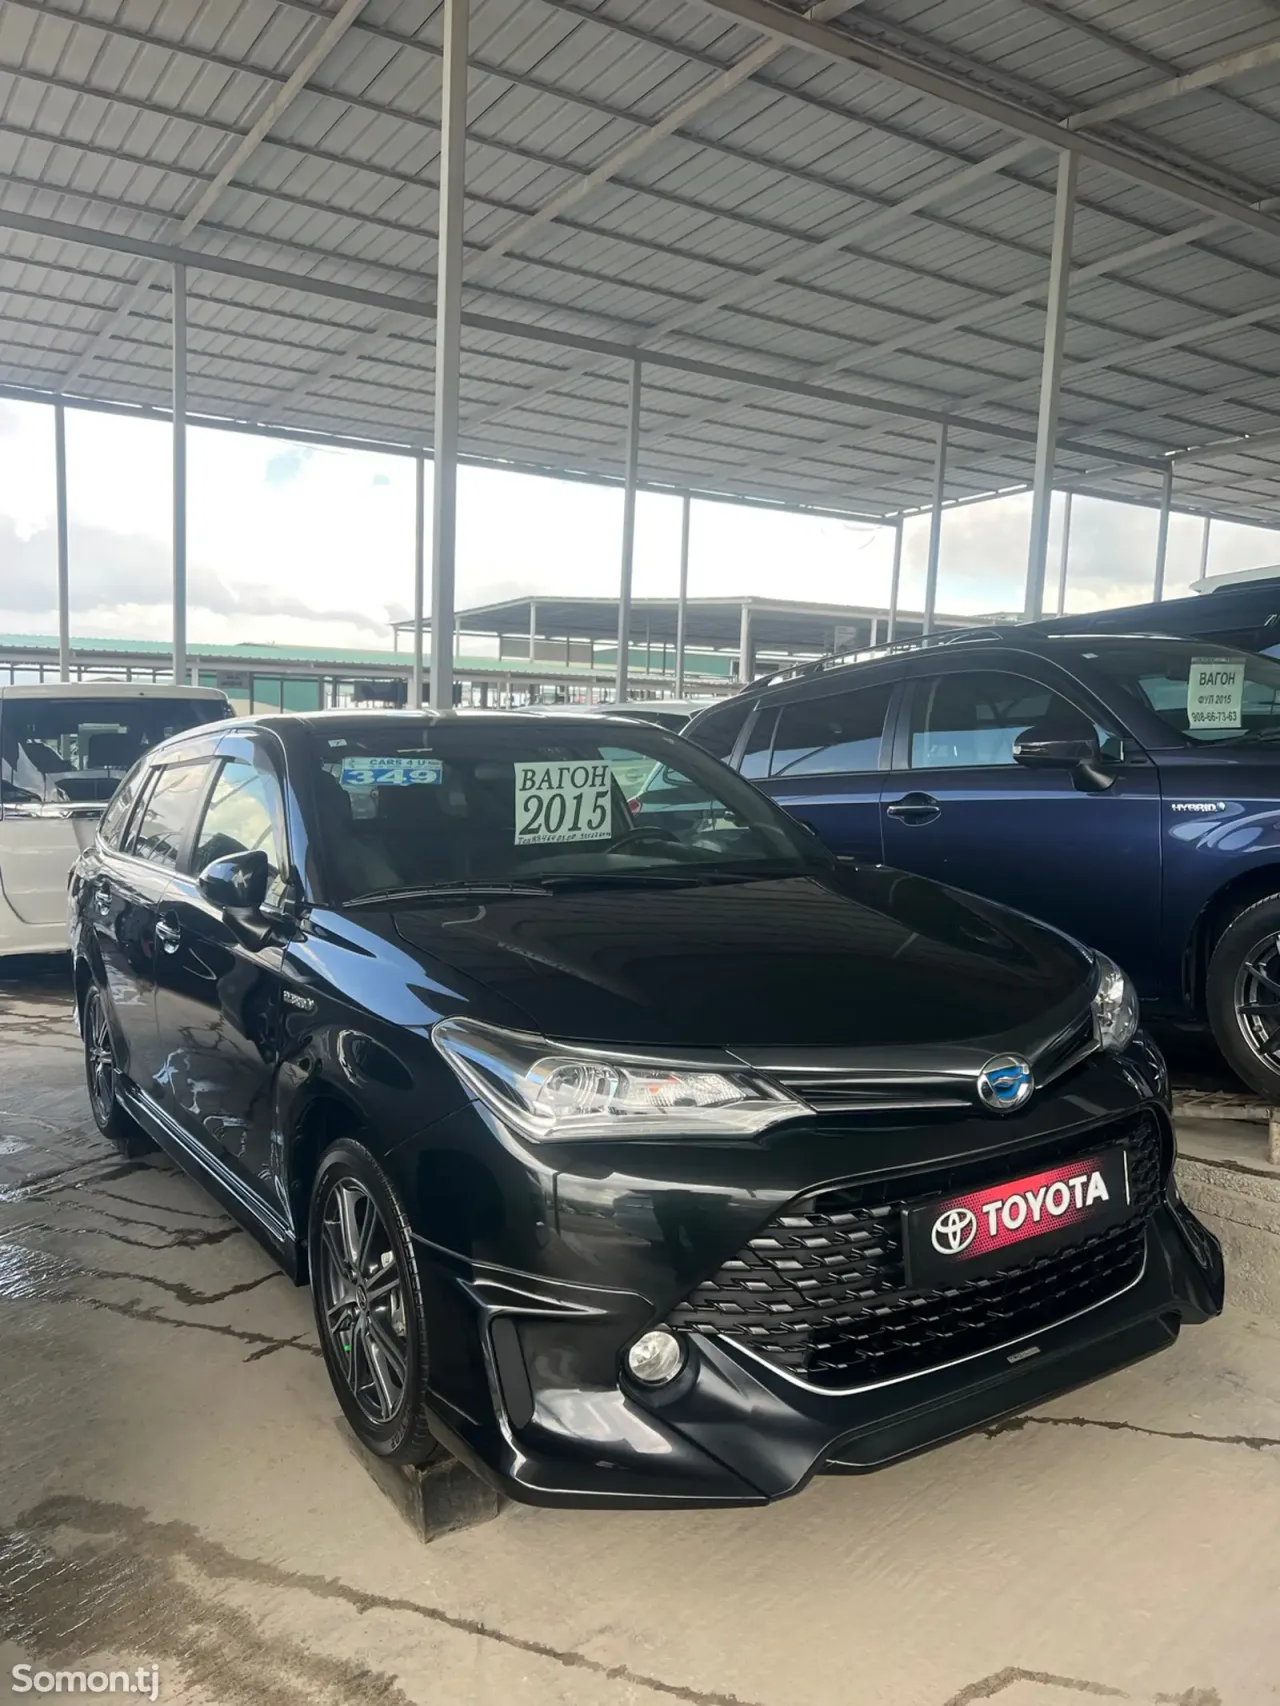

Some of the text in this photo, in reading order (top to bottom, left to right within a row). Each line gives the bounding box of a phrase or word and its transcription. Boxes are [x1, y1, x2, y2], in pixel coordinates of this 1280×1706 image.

[1199, 672, 1235, 686] ВАГОН
[1215, 694, 1232, 704] 2015
[369, 758, 402, 766] CARS
[406, 758, 414, 766] 4
[417, 758, 426, 766] U
[347, 769, 438, 785] 349
[519, 765, 609, 791] ВАГОН
[519, 790, 609, 835] 2015
[1171, 803, 1217, 812] HYBRID
[982, 1171, 1109, 1236] TOYOTA
